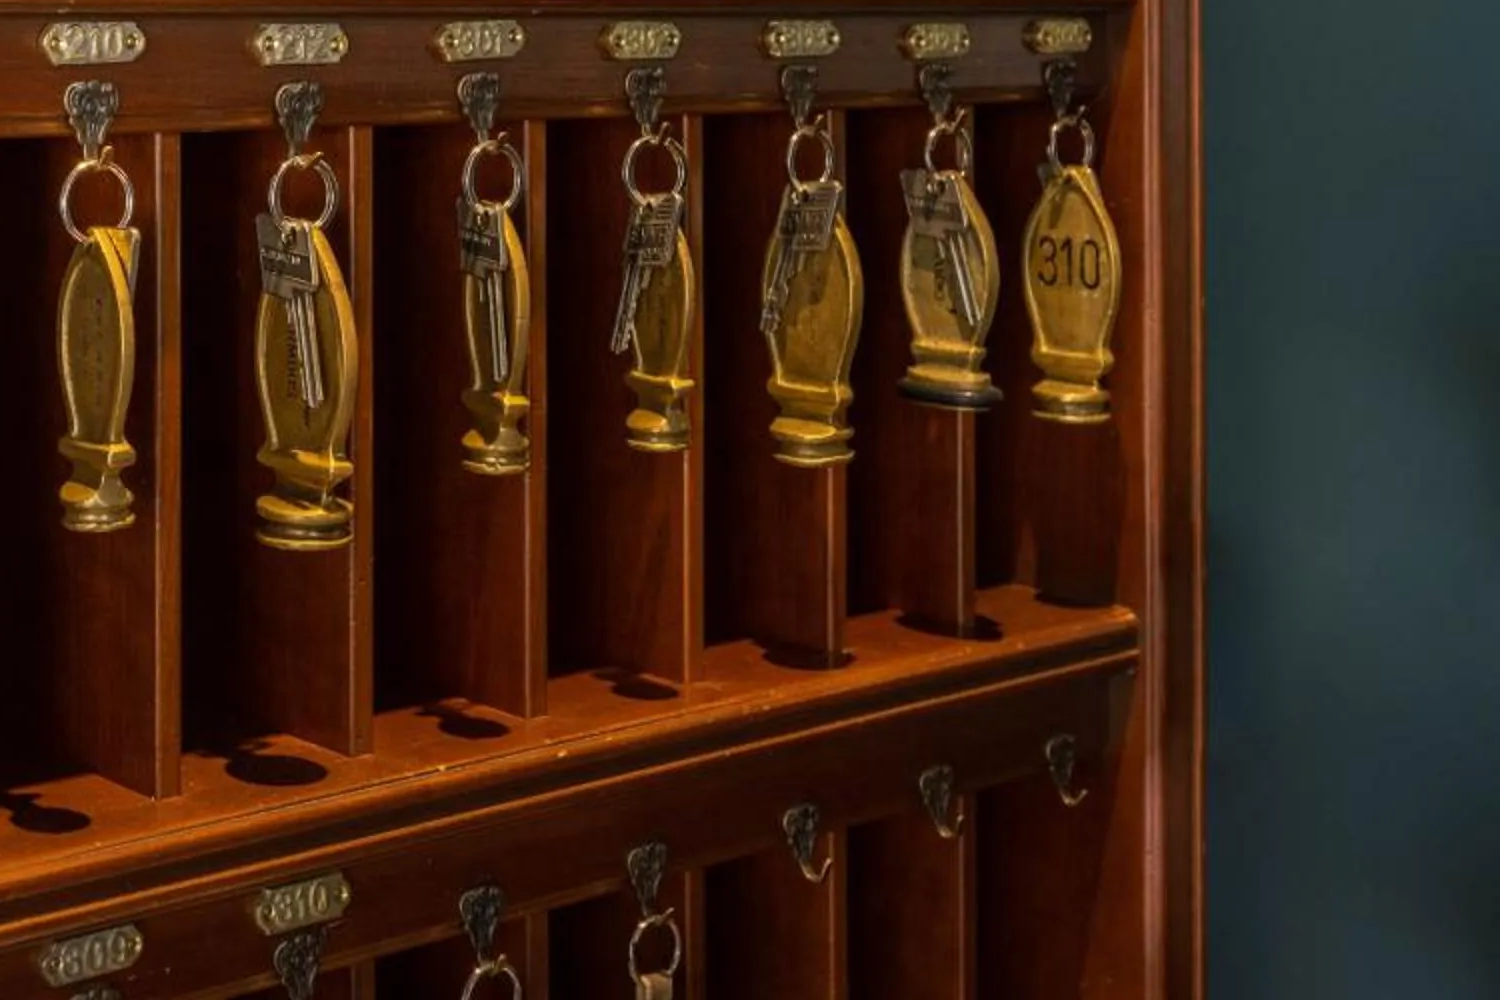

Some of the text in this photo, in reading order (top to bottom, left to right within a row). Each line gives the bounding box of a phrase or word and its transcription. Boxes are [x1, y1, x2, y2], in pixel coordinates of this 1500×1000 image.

[63, 23, 123, 60] 210
[1037, 235, 1100, 290] 310
[276, 878, 329, 924] 310
[65, 930, 128, 976] 309
